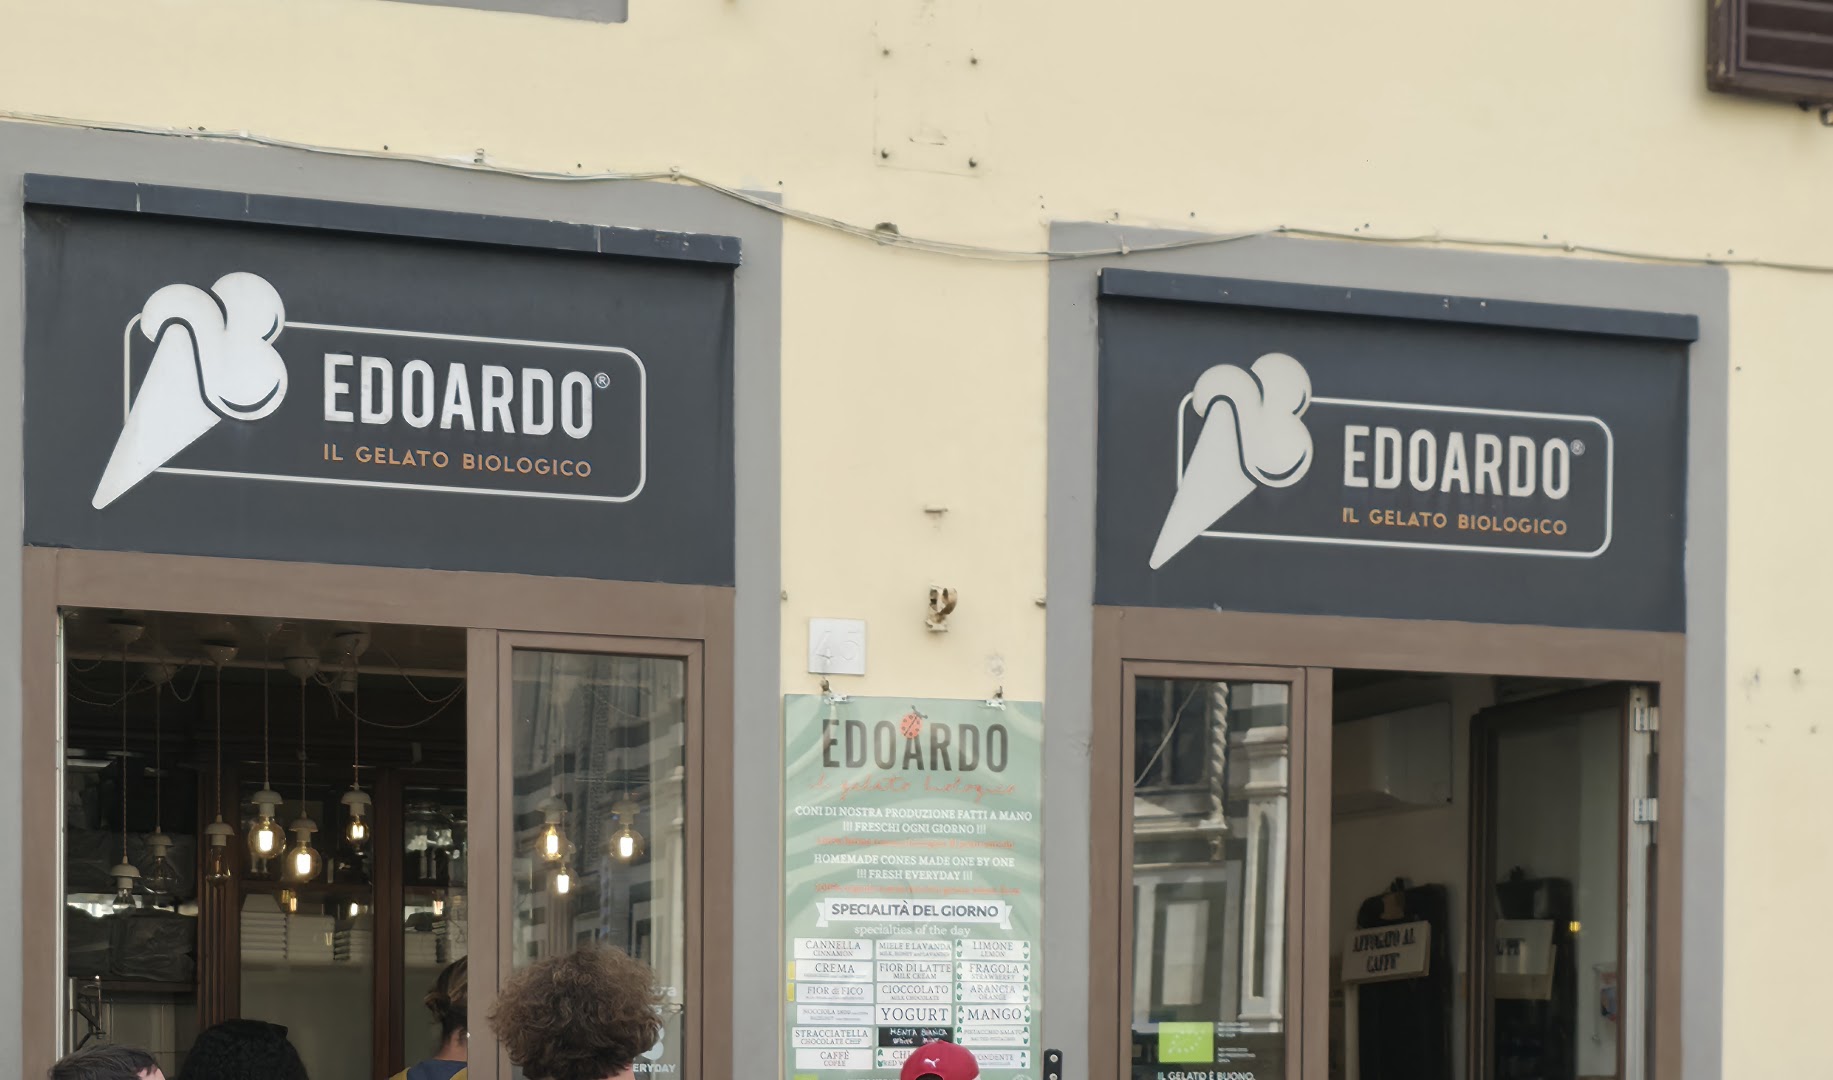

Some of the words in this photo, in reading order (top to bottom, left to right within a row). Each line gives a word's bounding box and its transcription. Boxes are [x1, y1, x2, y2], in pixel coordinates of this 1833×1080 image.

[323, 443, 344, 461] IL
[355, 445, 449, 468] GELATO
[462, 453, 592, 478] BIOLOGICO
[1342, 507, 1360, 523] IL
[1369, 509, 1447, 529] GELATO
[1458, 513, 1567, 536] BIOLOGICO
[822, 718, 1009, 773] EDOARDO
[795, 805, 823, 816] CONI
[825, 806, 838, 816] DI
[840, 807, 883, 817] NOSTRA
[885, 807, 956, 819] PRODUZIONE
[957, 809, 988, 820] FATTI
[990, 810, 998, 820] A
[999, 810, 1033, 822] MANO
[855, 821, 900, 833] FRESCHI
[902, 823, 930, 833] OGNI
[931, 823, 975, 834] GIORNO
[814, 853, 879, 864] HOMEMADE
[880, 855, 917, 865] CONES
[918, 855, 951, 866] MADE
[952, 856, 975, 867] ONE
[976, 857, 991, 867] BY
[992, 857, 1016, 867] ONE
[869, 869, 903, 880] FRESH
[905, 870, 961, 880] EVERYDAY
[831, 900, 909, 917] SPECIALITÀ
[912, 904, 940, 917] DEL
[941, 904, 999, 918] GIORNO
[854, 923, 912, 936] specialties
[914, 924, 928, 935] of
[928, 925, 948, 935] the
[950, 925, 972, 938] day
[805, 940, 861, 950] CANNELLA
[879, 942, 904, 950] MIELE
[905, 942, 911, 950] E
[912, 942, 952, 951] LAVANDA
[972, 941, 1014, 951] LIMONE
[815, 962, 855, 974] CREMA
[879, 963, 903, 973] FIOR
[906, 963, 917, 973] DI
[923, 963, 952, 973] LATTE
[969, 963, 1020, 974] FRAGOLA
[807, 986, 829, 995] FIOR
[841, 986, 864, 995] FICO
[881, 984, 949, 995] CIOCCOLATO
[969, 985, 1016, 994] ARANCIA
[881, 1007, 949, 1021] YOGURT
[967, 1007, 1022, 1021] MANGO
[795, 1029, 869, 1038] STRACCIATELLA
[889, 1027, 917, 1036] MENTA
[820, 1050, 850, 1060] CAFFÈ
[1168, 1071, 1207, 1080] GELATO
